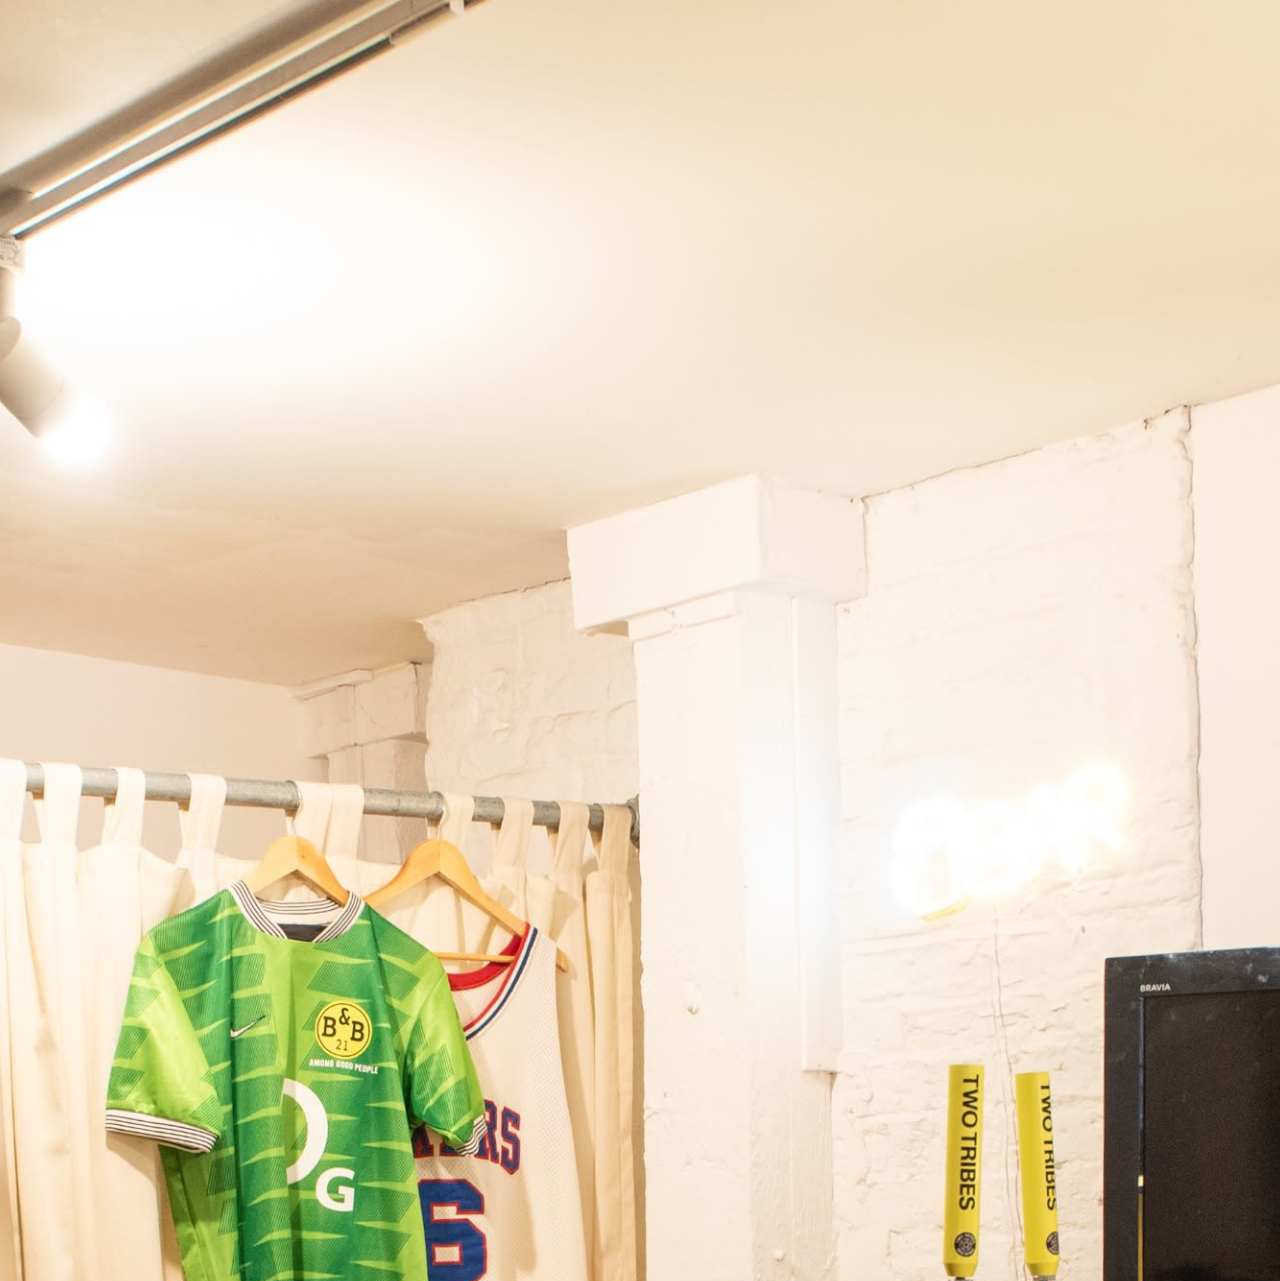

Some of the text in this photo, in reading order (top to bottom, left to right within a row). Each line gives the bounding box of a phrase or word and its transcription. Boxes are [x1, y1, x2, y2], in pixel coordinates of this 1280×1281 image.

[1140, 983, 1171, 993] BRAVIA
[335, 1040, 348, 1051] 21
[308, 1059, 378, 1075] AMONG GOOD PEOPLE
[961, 1074, 979, 1128] TWO
[959, 1131, 978, 1211] TRIBES
